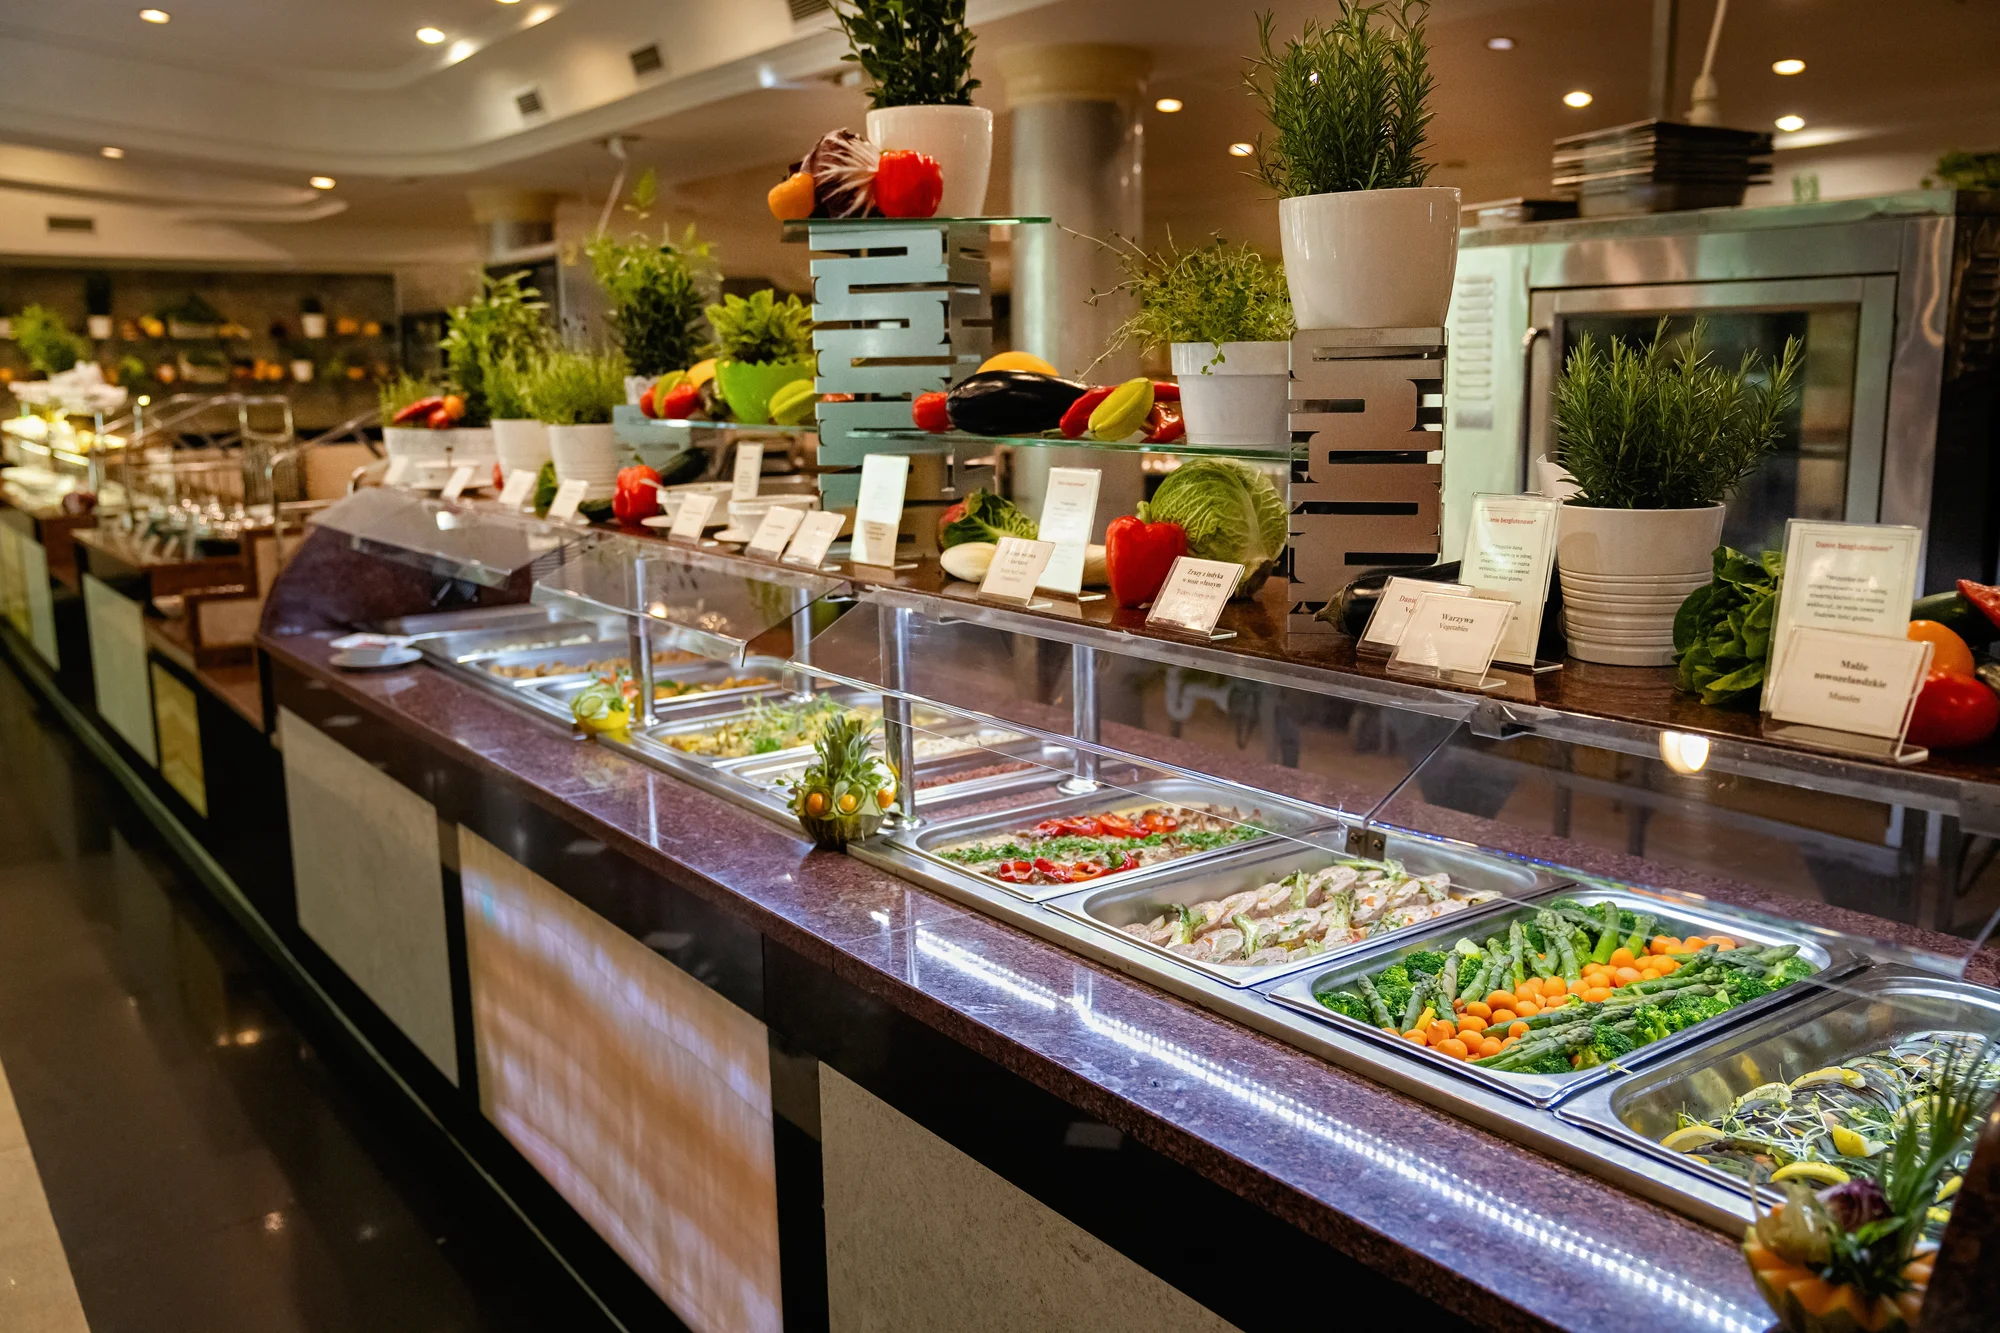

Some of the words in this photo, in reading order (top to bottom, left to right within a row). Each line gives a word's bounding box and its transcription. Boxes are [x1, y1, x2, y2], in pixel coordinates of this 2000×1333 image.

[1187, 569, 1202, 577] Zrazy
[1206, 571, 1224, 580] indyka
[1442, 613, 1474, 624] Warzywa
[1439, 623, 1469, 632] Vegetables
[1814, 672, 1887, 688] nowozelandzkie
